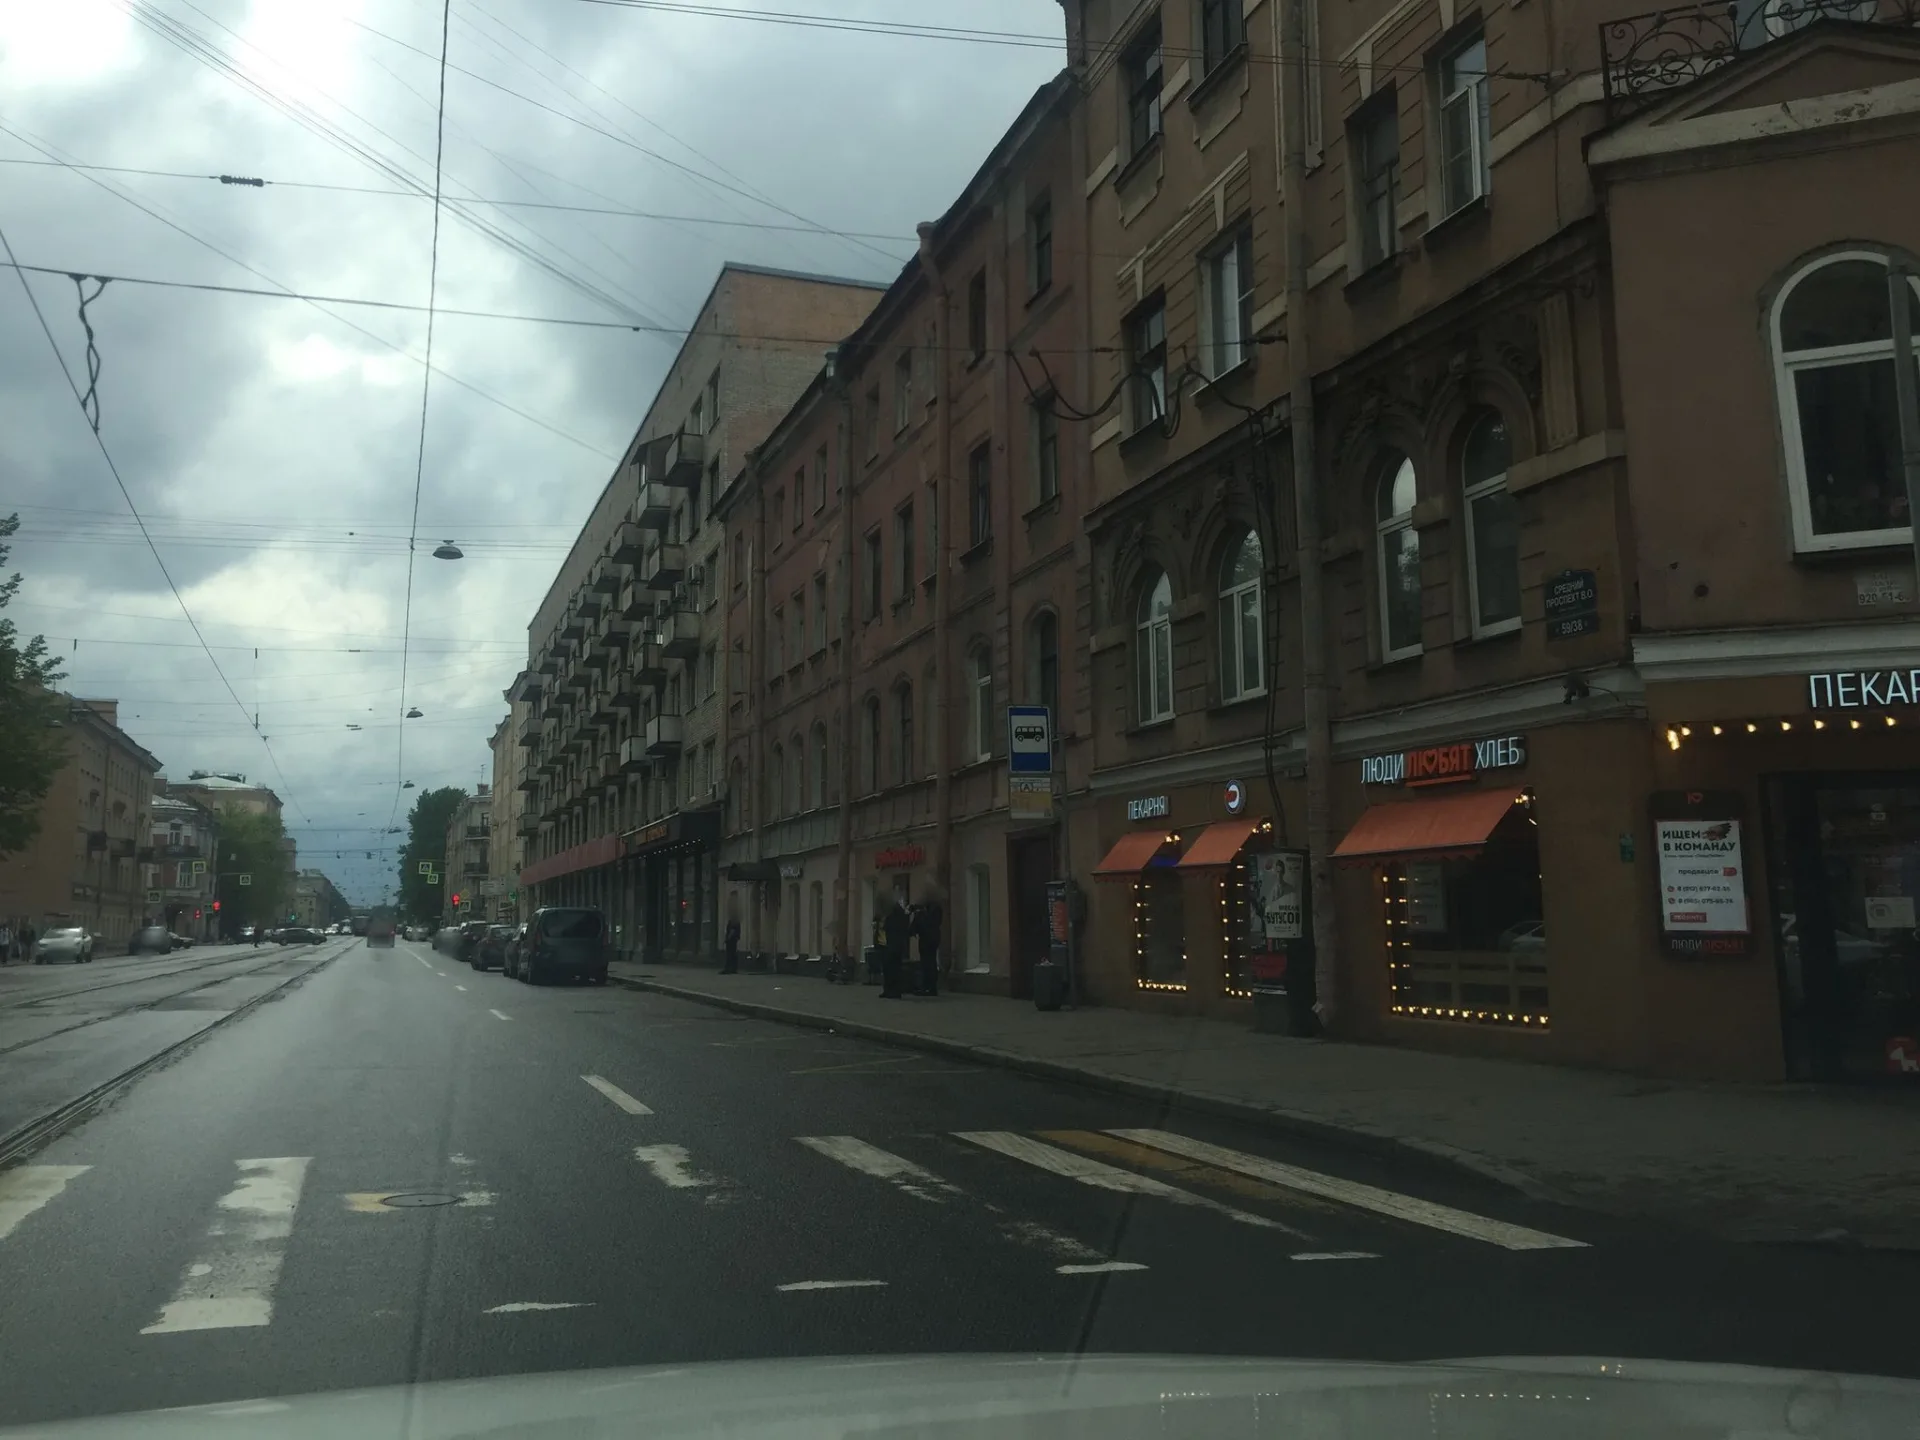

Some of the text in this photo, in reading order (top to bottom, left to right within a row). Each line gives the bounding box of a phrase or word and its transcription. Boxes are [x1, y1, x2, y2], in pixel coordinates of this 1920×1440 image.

[1546, 592, 1580, 608] ПРОСПЕКТ
[1361, 753, 1404, 784] ЛЮДИ
[1475, 737, 1521, 769] ХЛЕБ
[1128, 796, 1166, 820] ПЕКАРНЯ
[1662, 830, 1701, 840] ИЩЕМ
[1664, 842, 1736, 851] В КОМАНДУ
